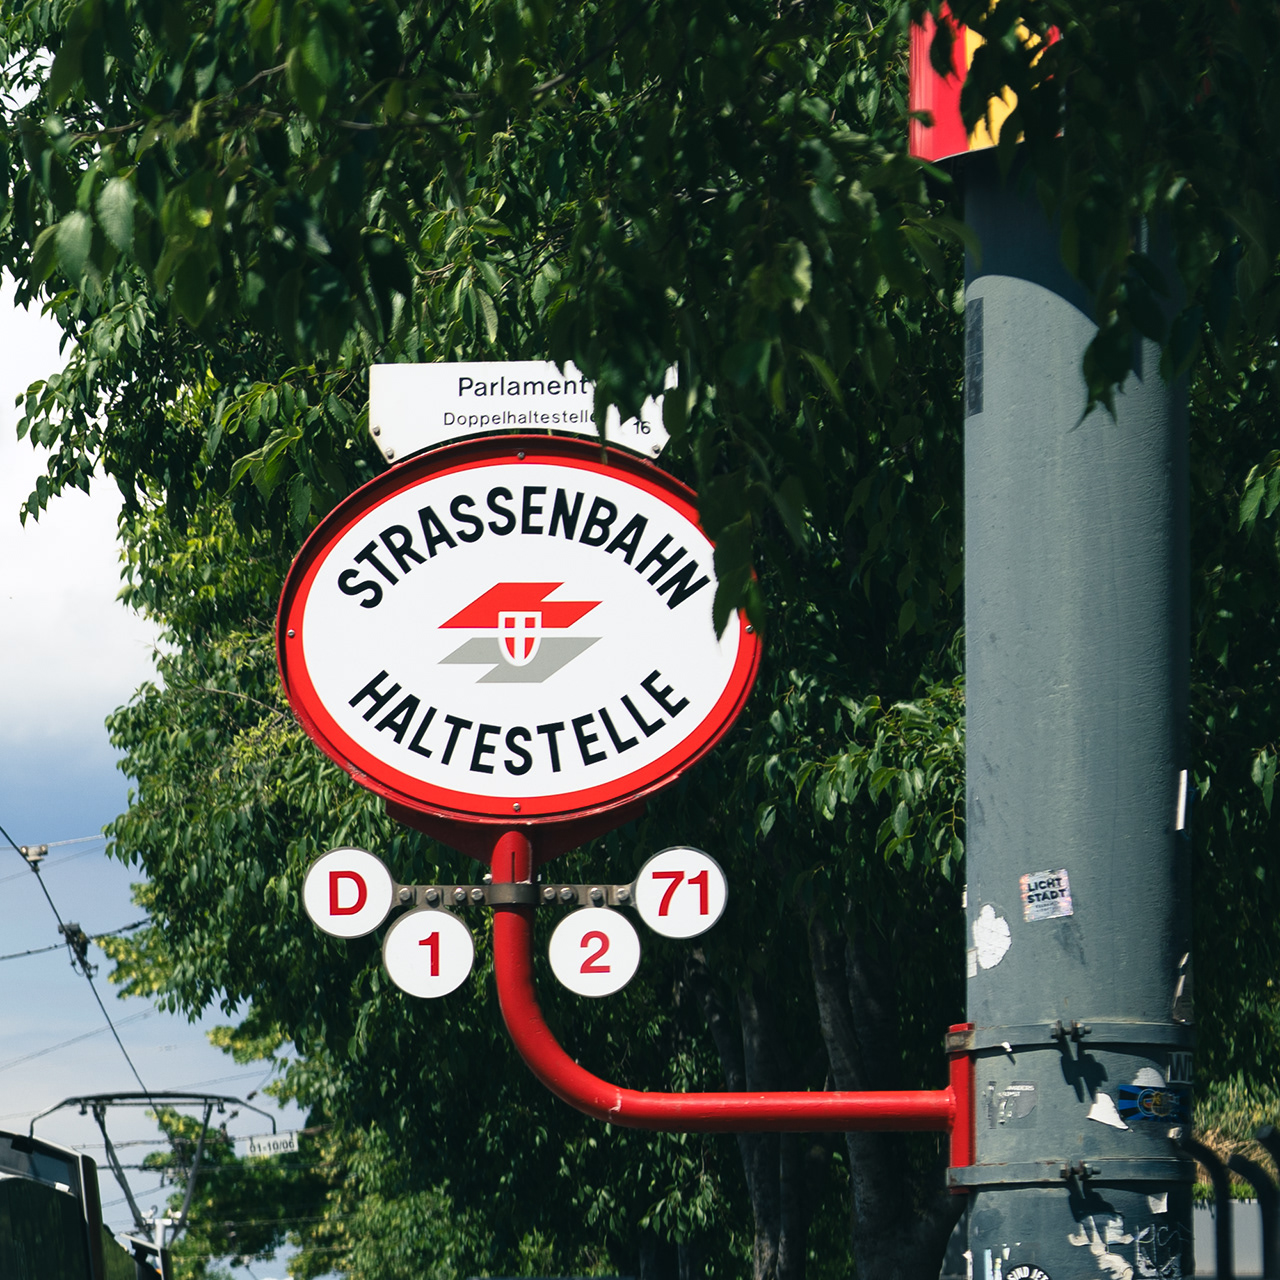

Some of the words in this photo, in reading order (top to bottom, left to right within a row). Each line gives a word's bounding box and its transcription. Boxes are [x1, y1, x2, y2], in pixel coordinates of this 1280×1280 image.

[458, 376, 589, 397] Parlament
[337, 485, 711, 610] STRASSENBAHN
[348, 669, 691, 776] HALTESTELLE
[329, 870, 368, 916] D
[651, 869, 710, 917] 71
[1027, 877, 1062, 892] LICHT
[1027, 889, 1066, 904] STADT
[418, 931, 441, 977] 1
[579, 930, 612, 974] 2
